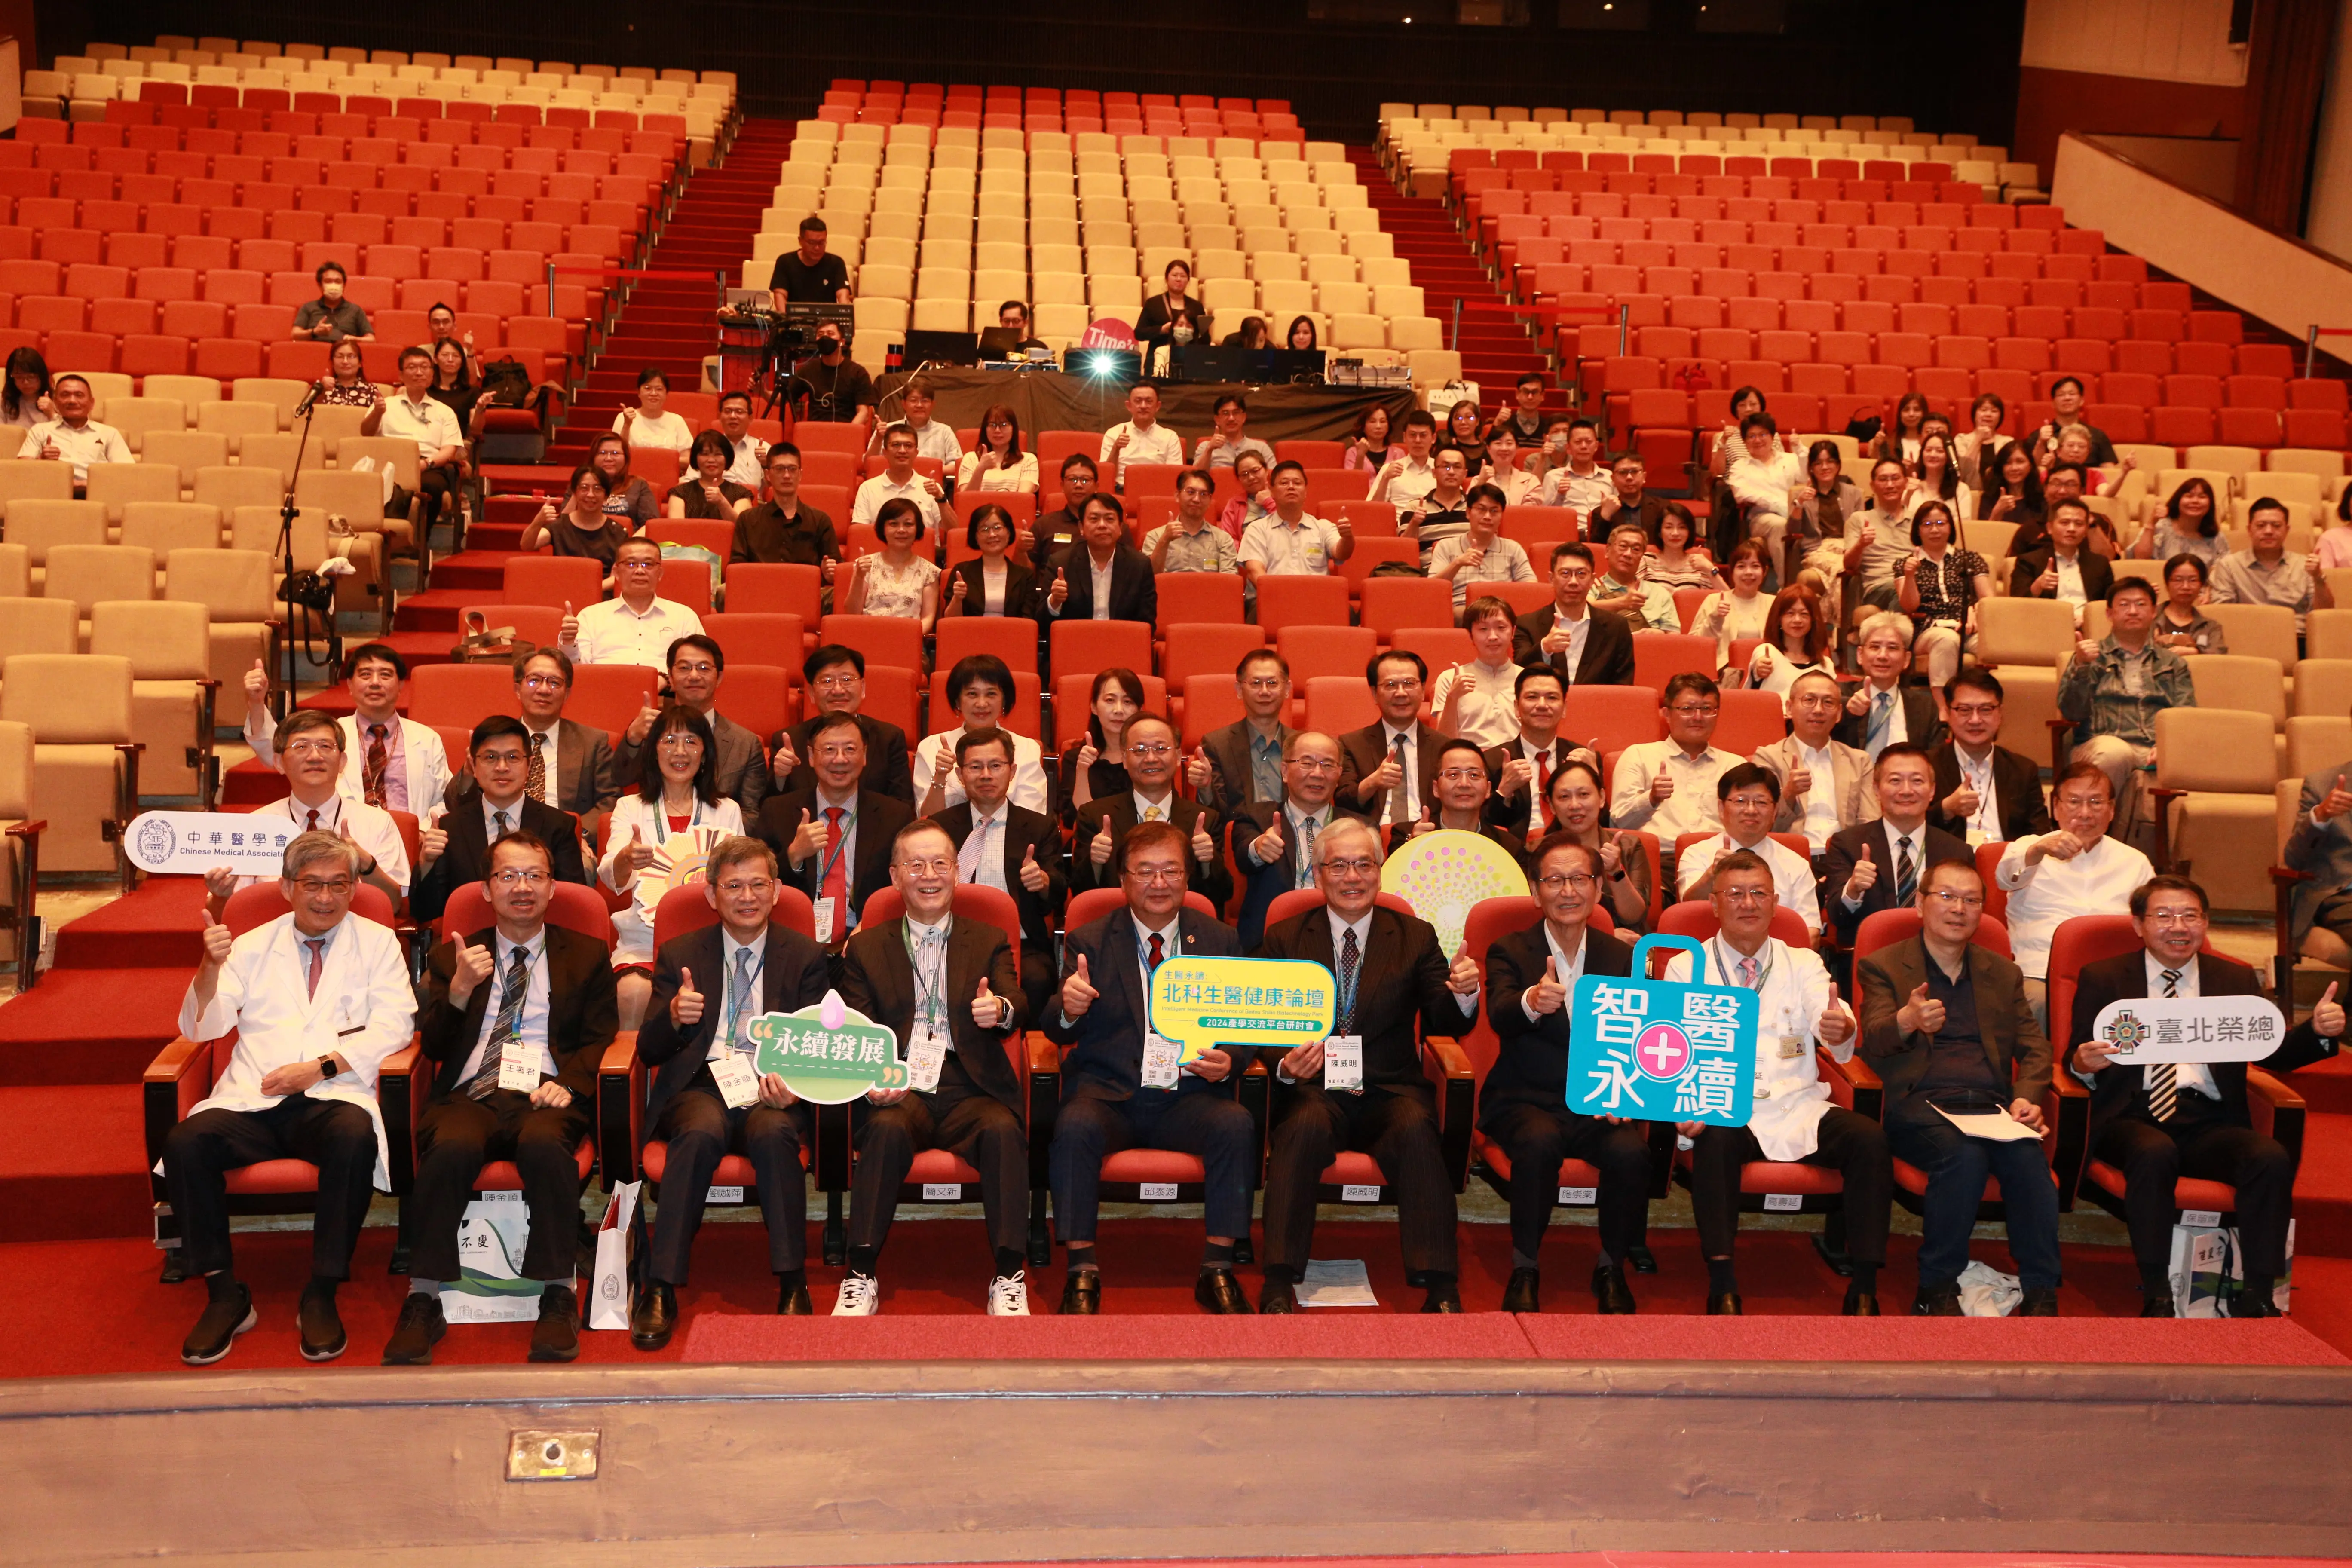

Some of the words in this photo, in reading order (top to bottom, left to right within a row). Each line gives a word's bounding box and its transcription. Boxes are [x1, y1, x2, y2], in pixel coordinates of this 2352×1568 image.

[188, 830, 288, 847] 中華醫學會
[1162, 983, 1324, 1008] 北科生醫健康論壇
[1207, 1018, 1314, 1030] 2024產學交流平台研討會
[2156, 1015, 2275, 1044] 臺北榮總
[773, 1028, 885, 1064] 永續發展
[1331, 1059, 1357, 1068] 陳威明
[723, 1074, 752, 1089] 陳金順
[709, 1188, 741, 1197] 劉越萍
[926, 1187, 957, 1197] 簡又新
[1145, 1187, 1176, 1196] 邱泰源
[1348, 1188, 1378, 1197] 陳威明
[1562, 1190, 1592, 1198] 施崇棠
